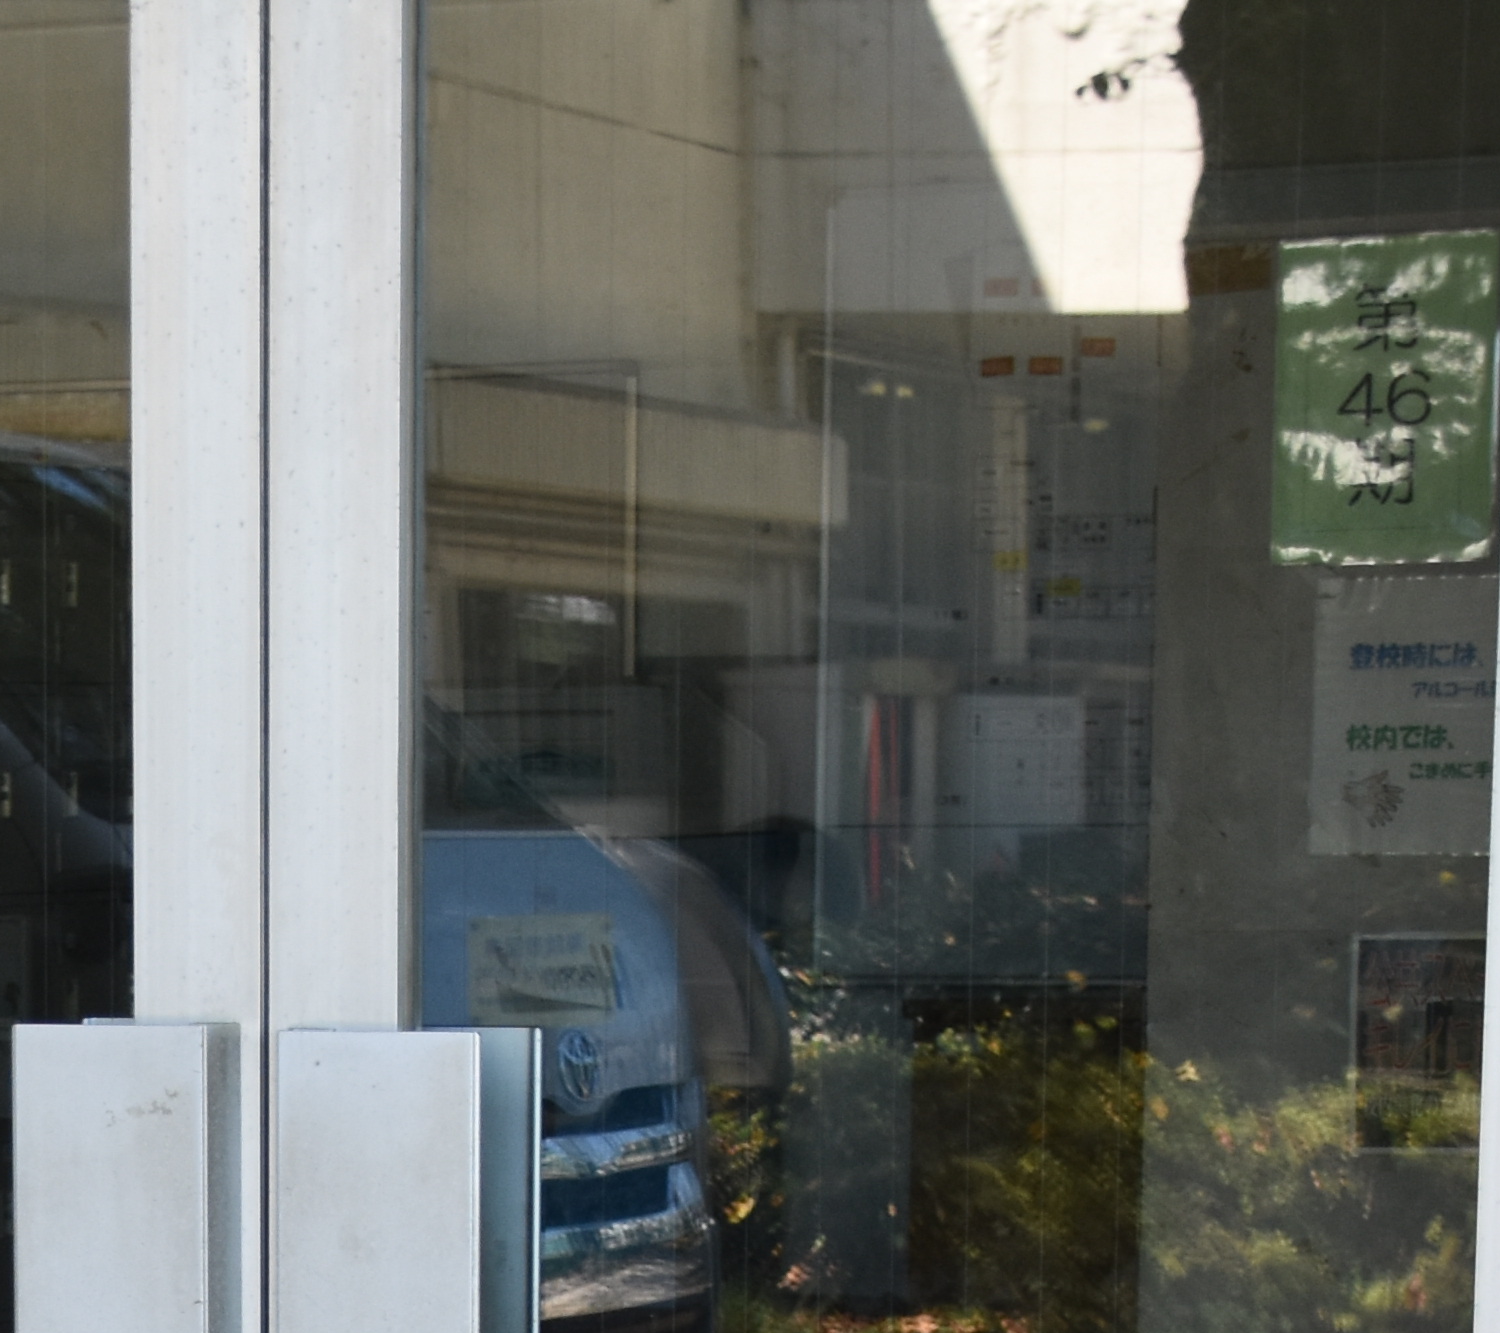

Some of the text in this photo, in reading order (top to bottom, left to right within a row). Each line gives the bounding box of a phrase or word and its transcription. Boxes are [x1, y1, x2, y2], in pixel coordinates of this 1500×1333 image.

[1350, 641, 1484, 670] 登校時には、
[1411, 679, 1497, 698] アルコール
[1346, 723, 1454, 751] 校内では、
